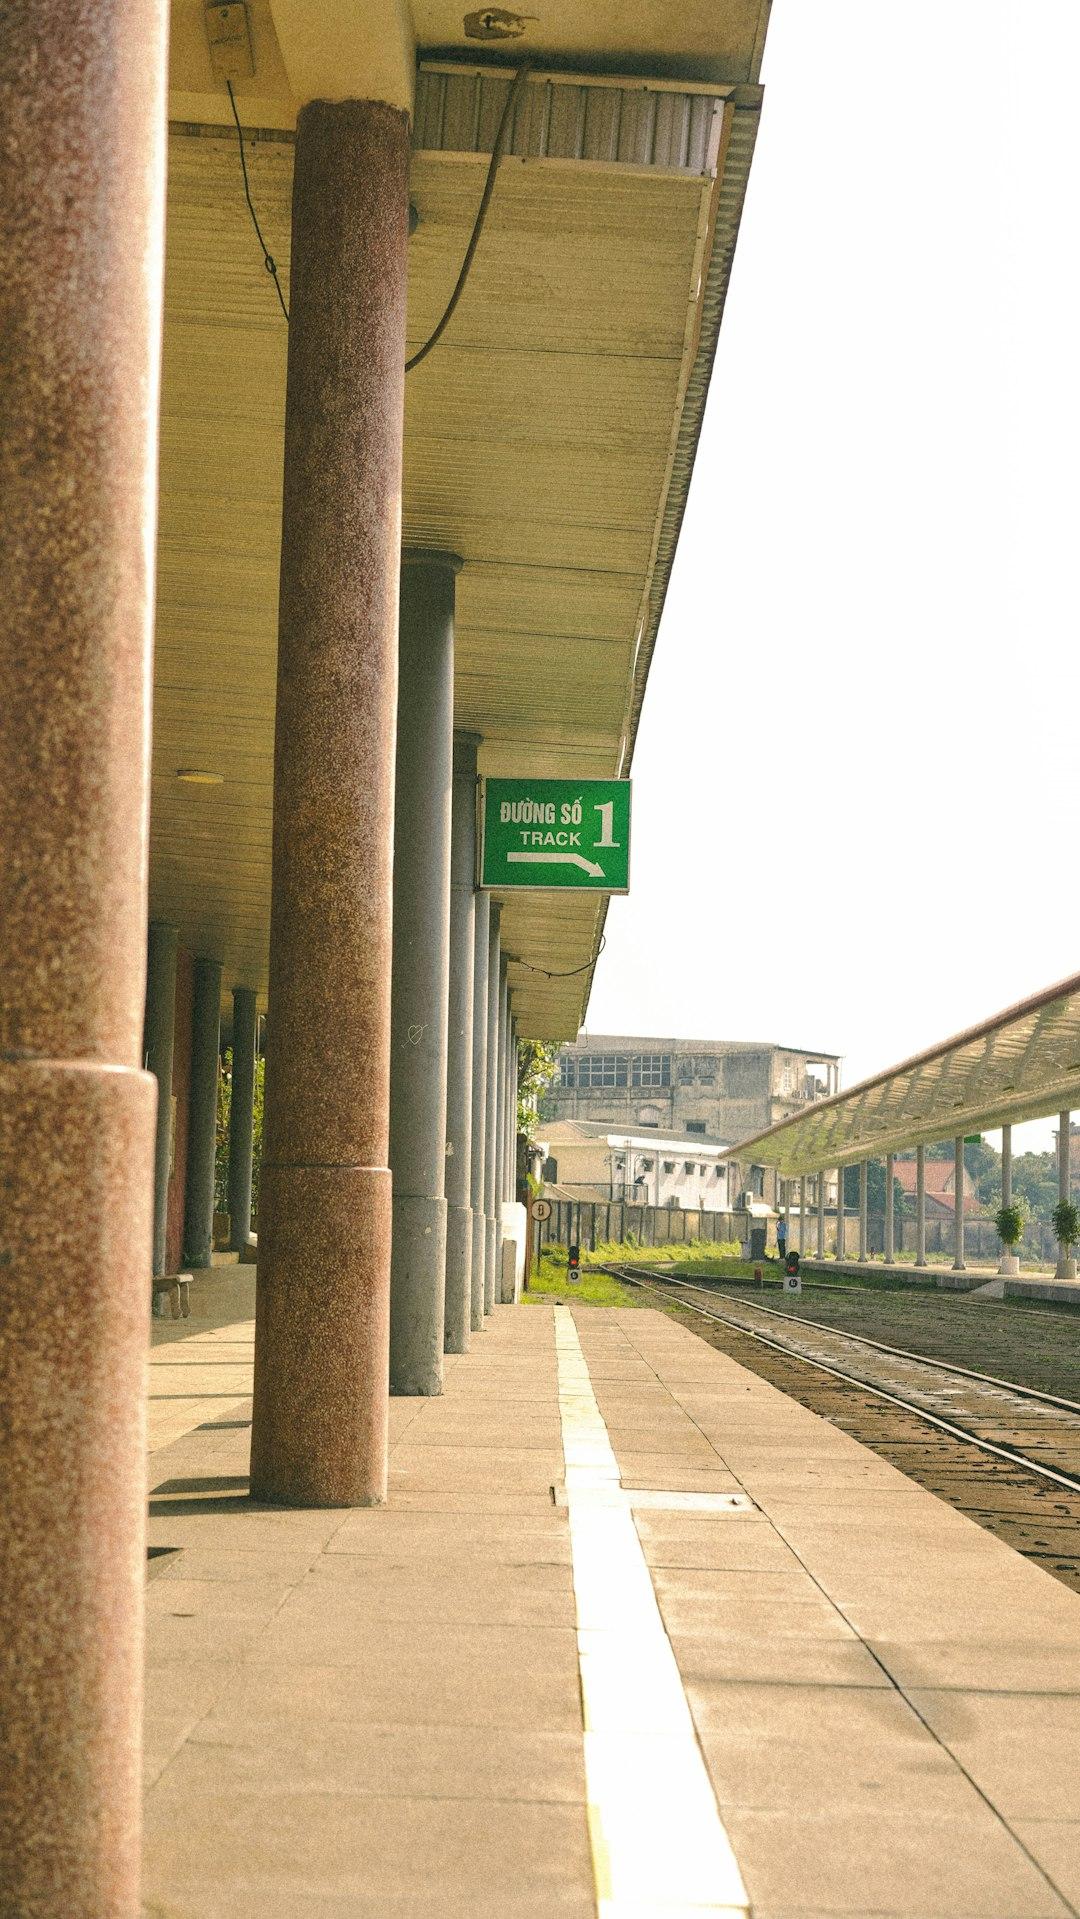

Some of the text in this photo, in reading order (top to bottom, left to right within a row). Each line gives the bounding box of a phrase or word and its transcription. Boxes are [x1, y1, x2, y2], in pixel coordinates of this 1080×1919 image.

[499, 796, 621, 848] ĐƯỜNG SỐ 1
[520, 831, 582, 846] TRACK
